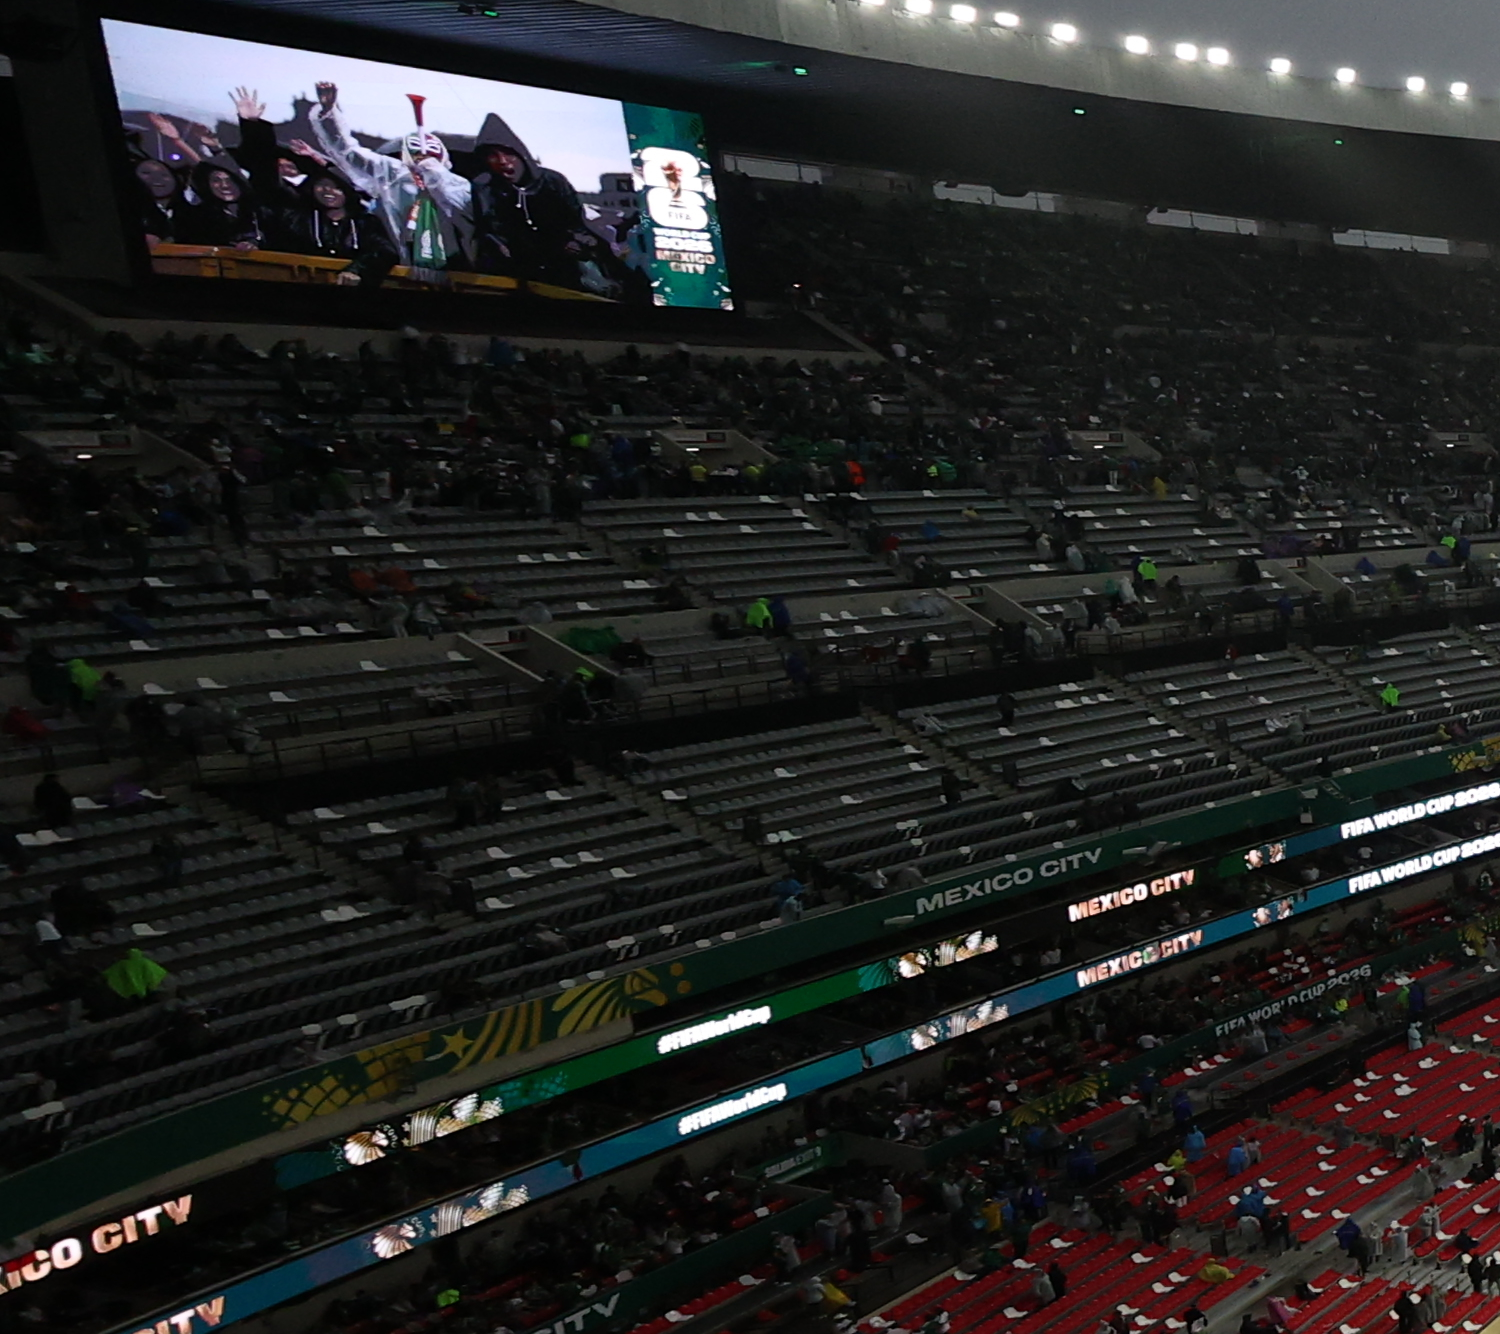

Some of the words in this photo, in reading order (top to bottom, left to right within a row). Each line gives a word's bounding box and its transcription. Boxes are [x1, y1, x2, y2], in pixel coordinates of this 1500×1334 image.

[656, 250, 715, 264] MEXICO
[669, 262, 705, 275] CITY
[1340, 814, 1375, 840] FIFA
[1376, 803, 1426, 830] WORLD
[1426, 794, 1455, 816] CUP
[916, 866, 1033, 915] MEXICO
[1039, 847, 1103, 878] CITY
[1348, 869, 1381, 894] FIFA
[1381, 855, 1433, 886] WORLD
[1433, 845, 1461, 867] CUP
[1068, 883, 1148, 922] MEXICO
[1150, 869, 1195, 896] CITY
[1159, 929, 1204, 957] CITY
[1300, 983, 1326, 1004] CUP
[656, 1004, 772, 1055] #FIFAWorldCup
[677, 1082, 787, 1136] #FIFAWorldCup
[92, 1194, 193, 1253] CITY
